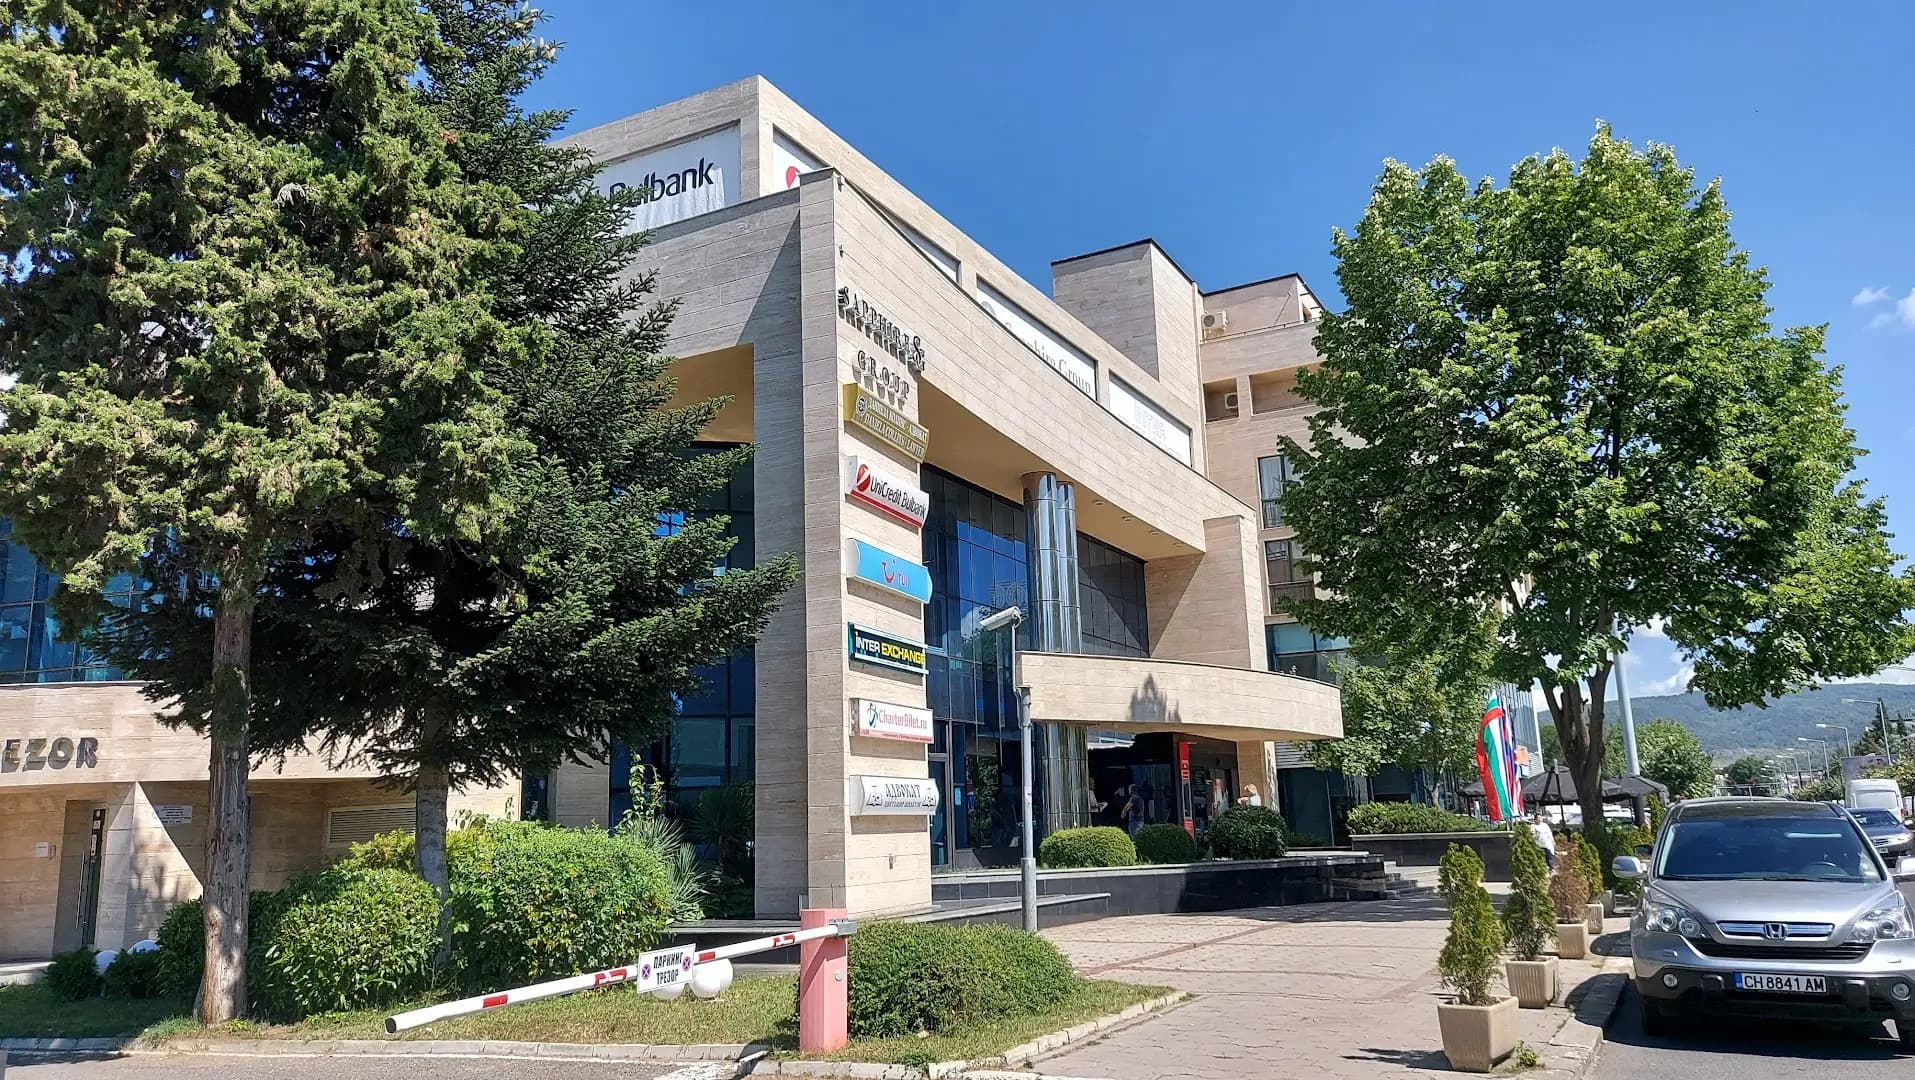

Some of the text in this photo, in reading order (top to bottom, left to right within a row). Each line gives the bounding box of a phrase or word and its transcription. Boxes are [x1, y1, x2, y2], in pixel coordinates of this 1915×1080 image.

[609, 157, 714, 205] Blbank
[858, 350, 910, 399] GROUP
[870, 475, 926, 518] UniCredit Bulbank
[879, 707, 928, 730] CharterBilet.ru
[885, 783, 921, 800] АДВОКАТ
[653, 951, 684, 968] ПАРКИНГ
[656, 969, 679, 985] ТРЕЗОР
[1744, 975, 1763, 988] CH
[1766, 976, 1800, 990] 8841
[1805, 978, 1824, 992] AM
